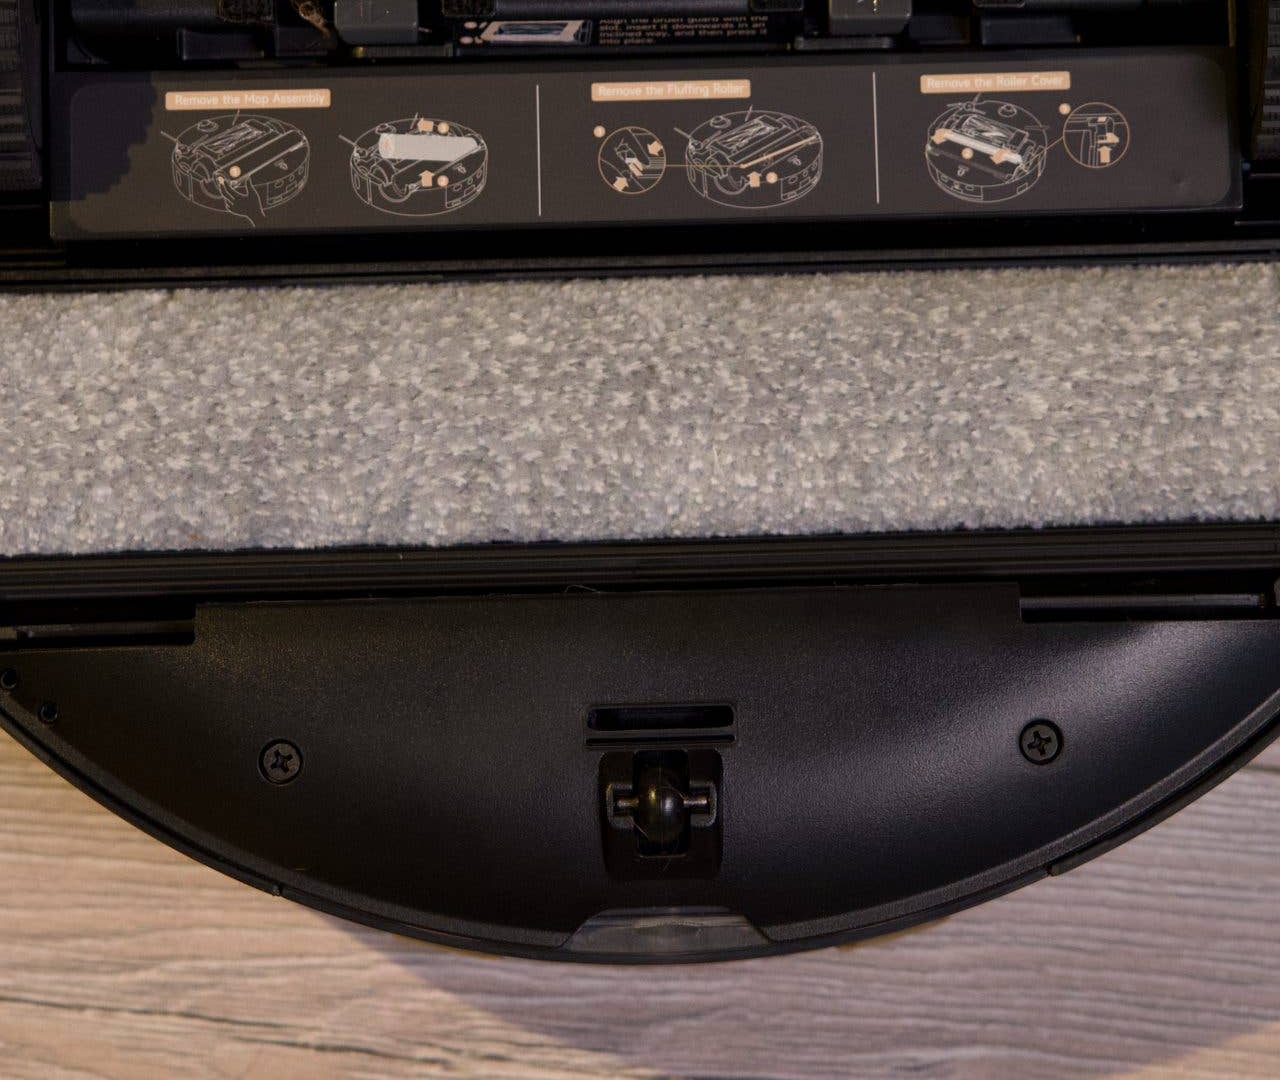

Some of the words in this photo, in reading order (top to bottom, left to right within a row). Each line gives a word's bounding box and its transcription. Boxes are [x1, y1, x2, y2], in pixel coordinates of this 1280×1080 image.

[927, 78, 970, 89] Remove
[975, 77, 992, 88] the
[997, 76, 1026, 87] Roller
[1032, 74, 1062, 86] Cover
[598, 86, 642, 97] Remove
[645, 85, 663, 96] the
[667, 84, 709, 98] Fluffing
[714, 83, 744, 95] Roller
[175, 94, 219, 105] Remove
[222, 94, 241, 105] the
[244, 93, 269, 106] Mop
[271, 92, 325, 106] Assembly
